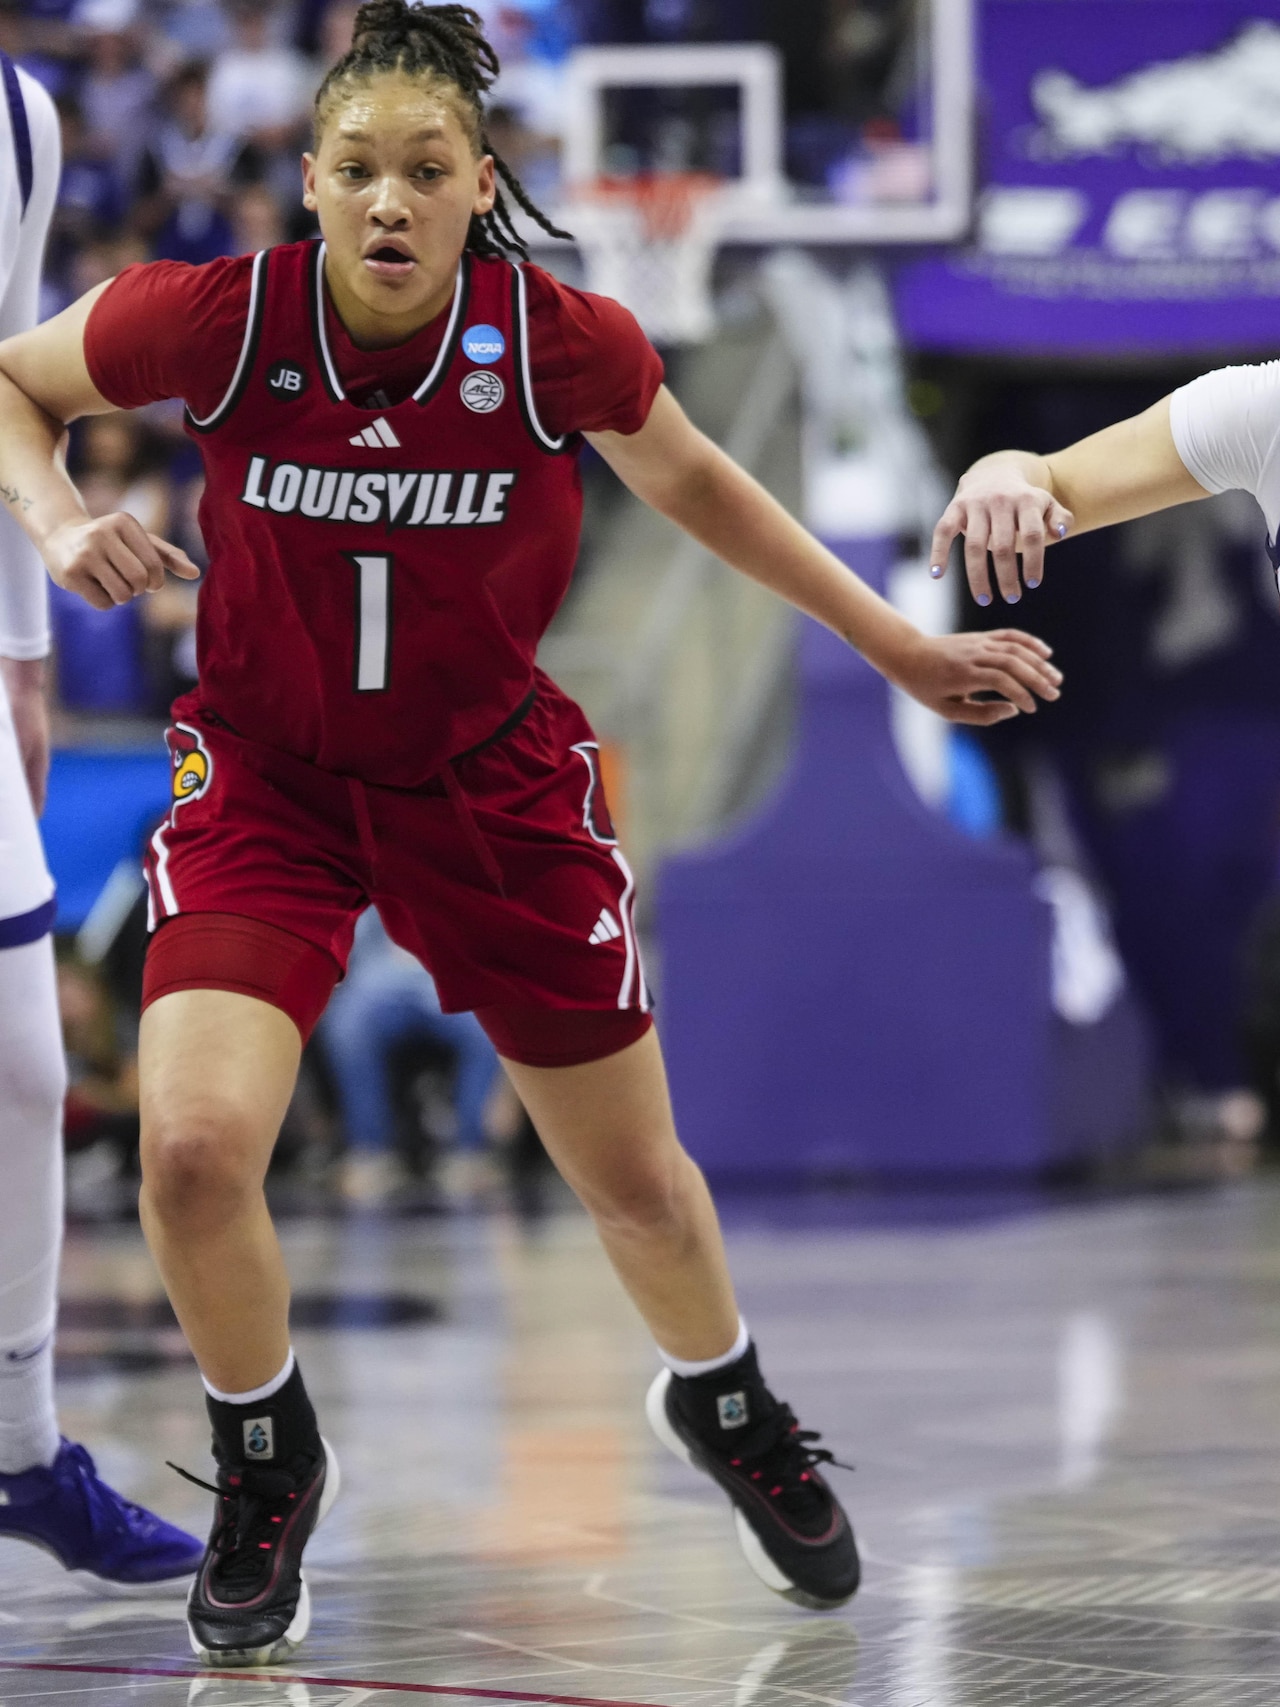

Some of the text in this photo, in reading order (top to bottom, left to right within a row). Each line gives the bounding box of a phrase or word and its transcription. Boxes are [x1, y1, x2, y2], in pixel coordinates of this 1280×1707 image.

[468, 342, 503, 354] NCAA
[270, 368, 301, 391] JB
[467, 383, 499, 396] ACC
[240, 455, 516, 528] LOUISVILLE
[346, 553, 391, 693] 1
